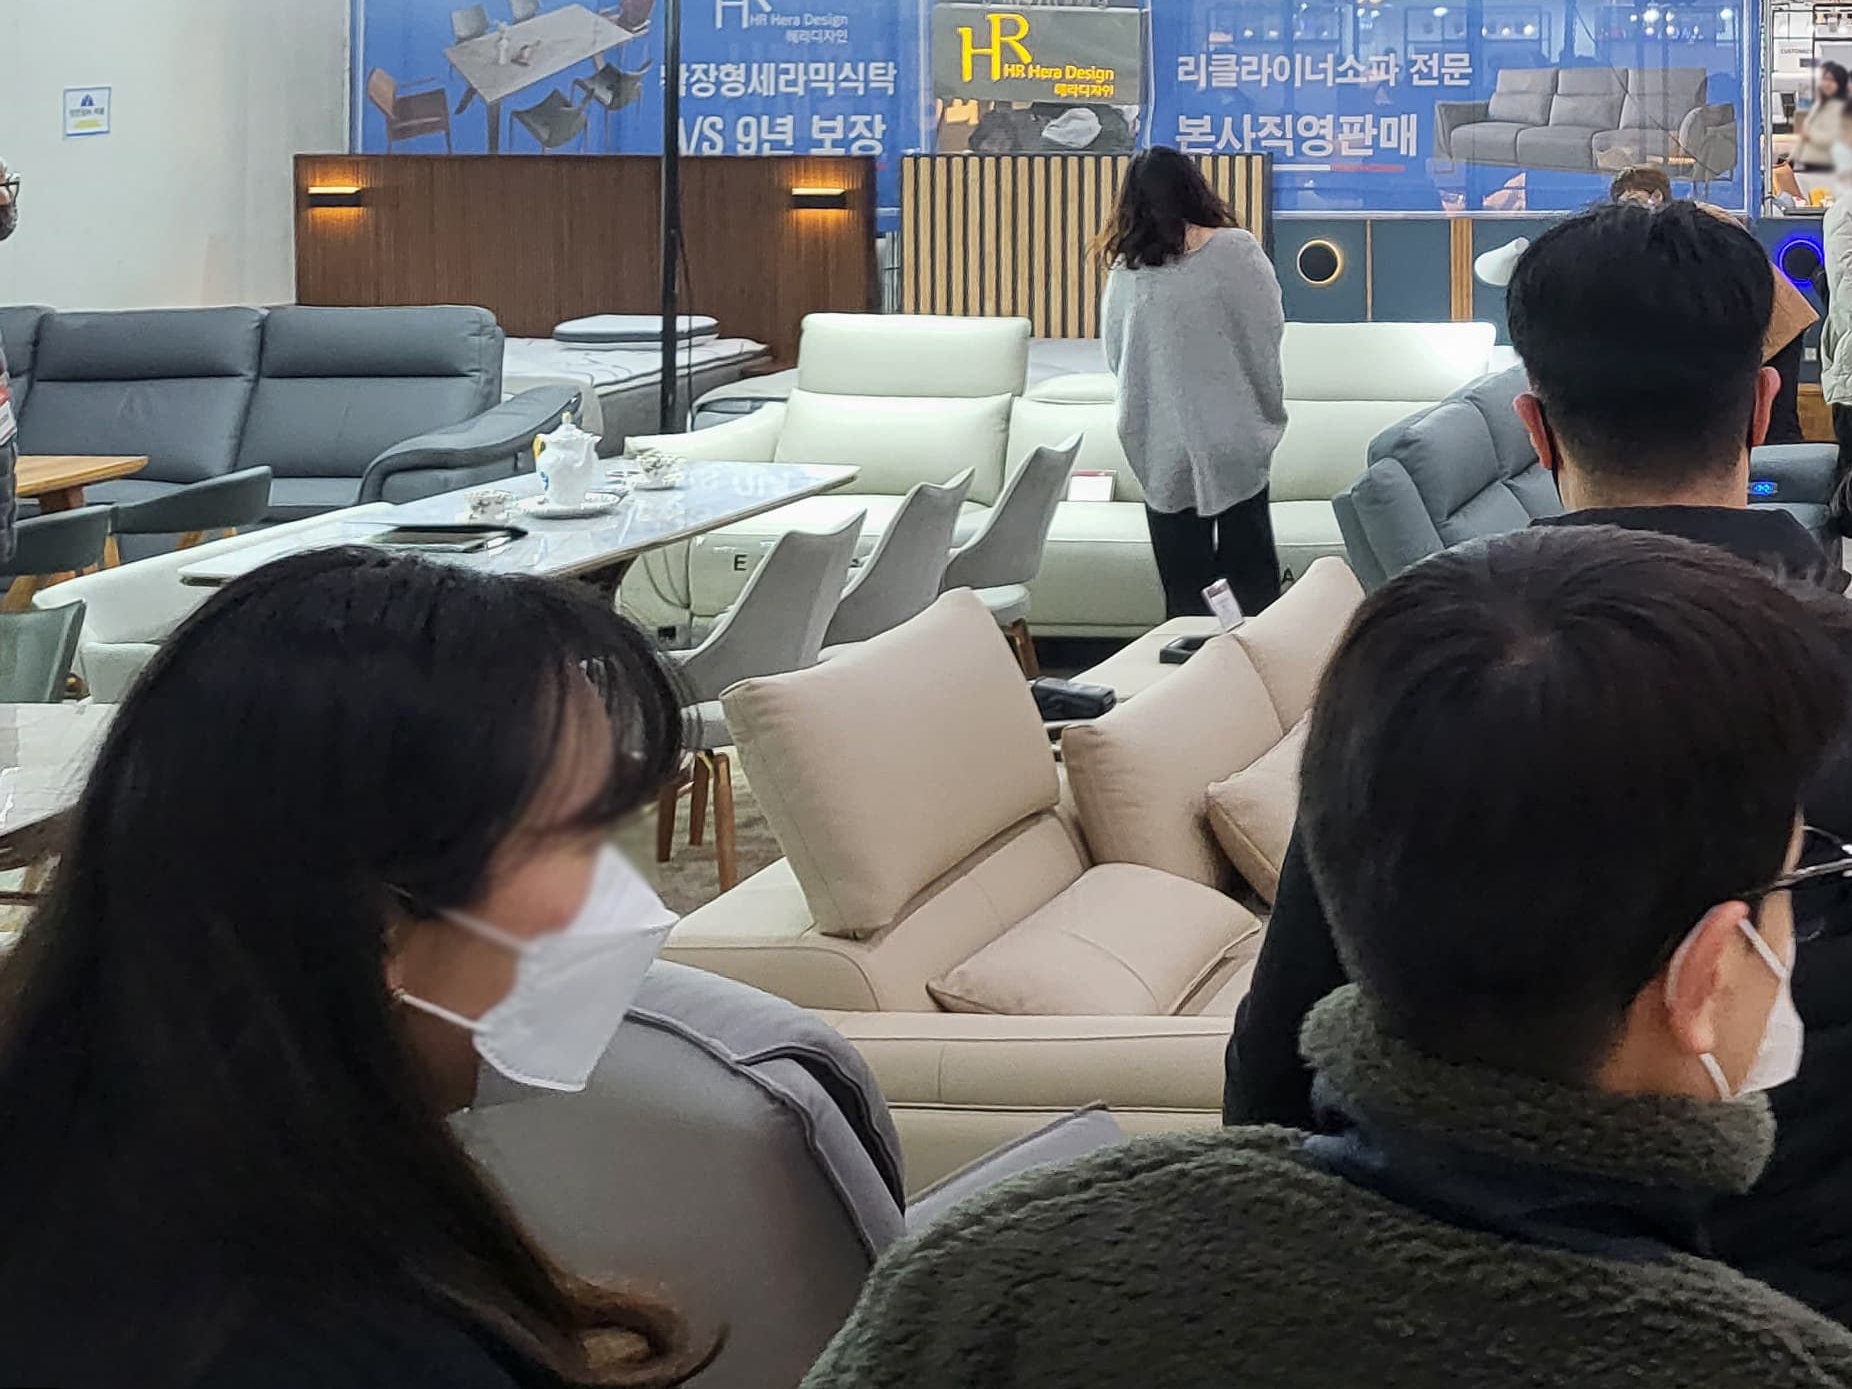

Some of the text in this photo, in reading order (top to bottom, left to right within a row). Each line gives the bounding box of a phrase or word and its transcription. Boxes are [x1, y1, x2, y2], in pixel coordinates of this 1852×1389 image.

[770, 13, 801, 26] Hera
[804, 13, 849, 30] Design
[957, 11, 1033, 82] HR
[1003, 64, 1115, 82] HR Hera Design
[1177, 52, 1473, 87] 리클라이너소파 전문
[735, 114, 795, 156] 9년
[810, 113, 887, 156] 보장
[1175, 113, 1419, 157] 본사직영판매
